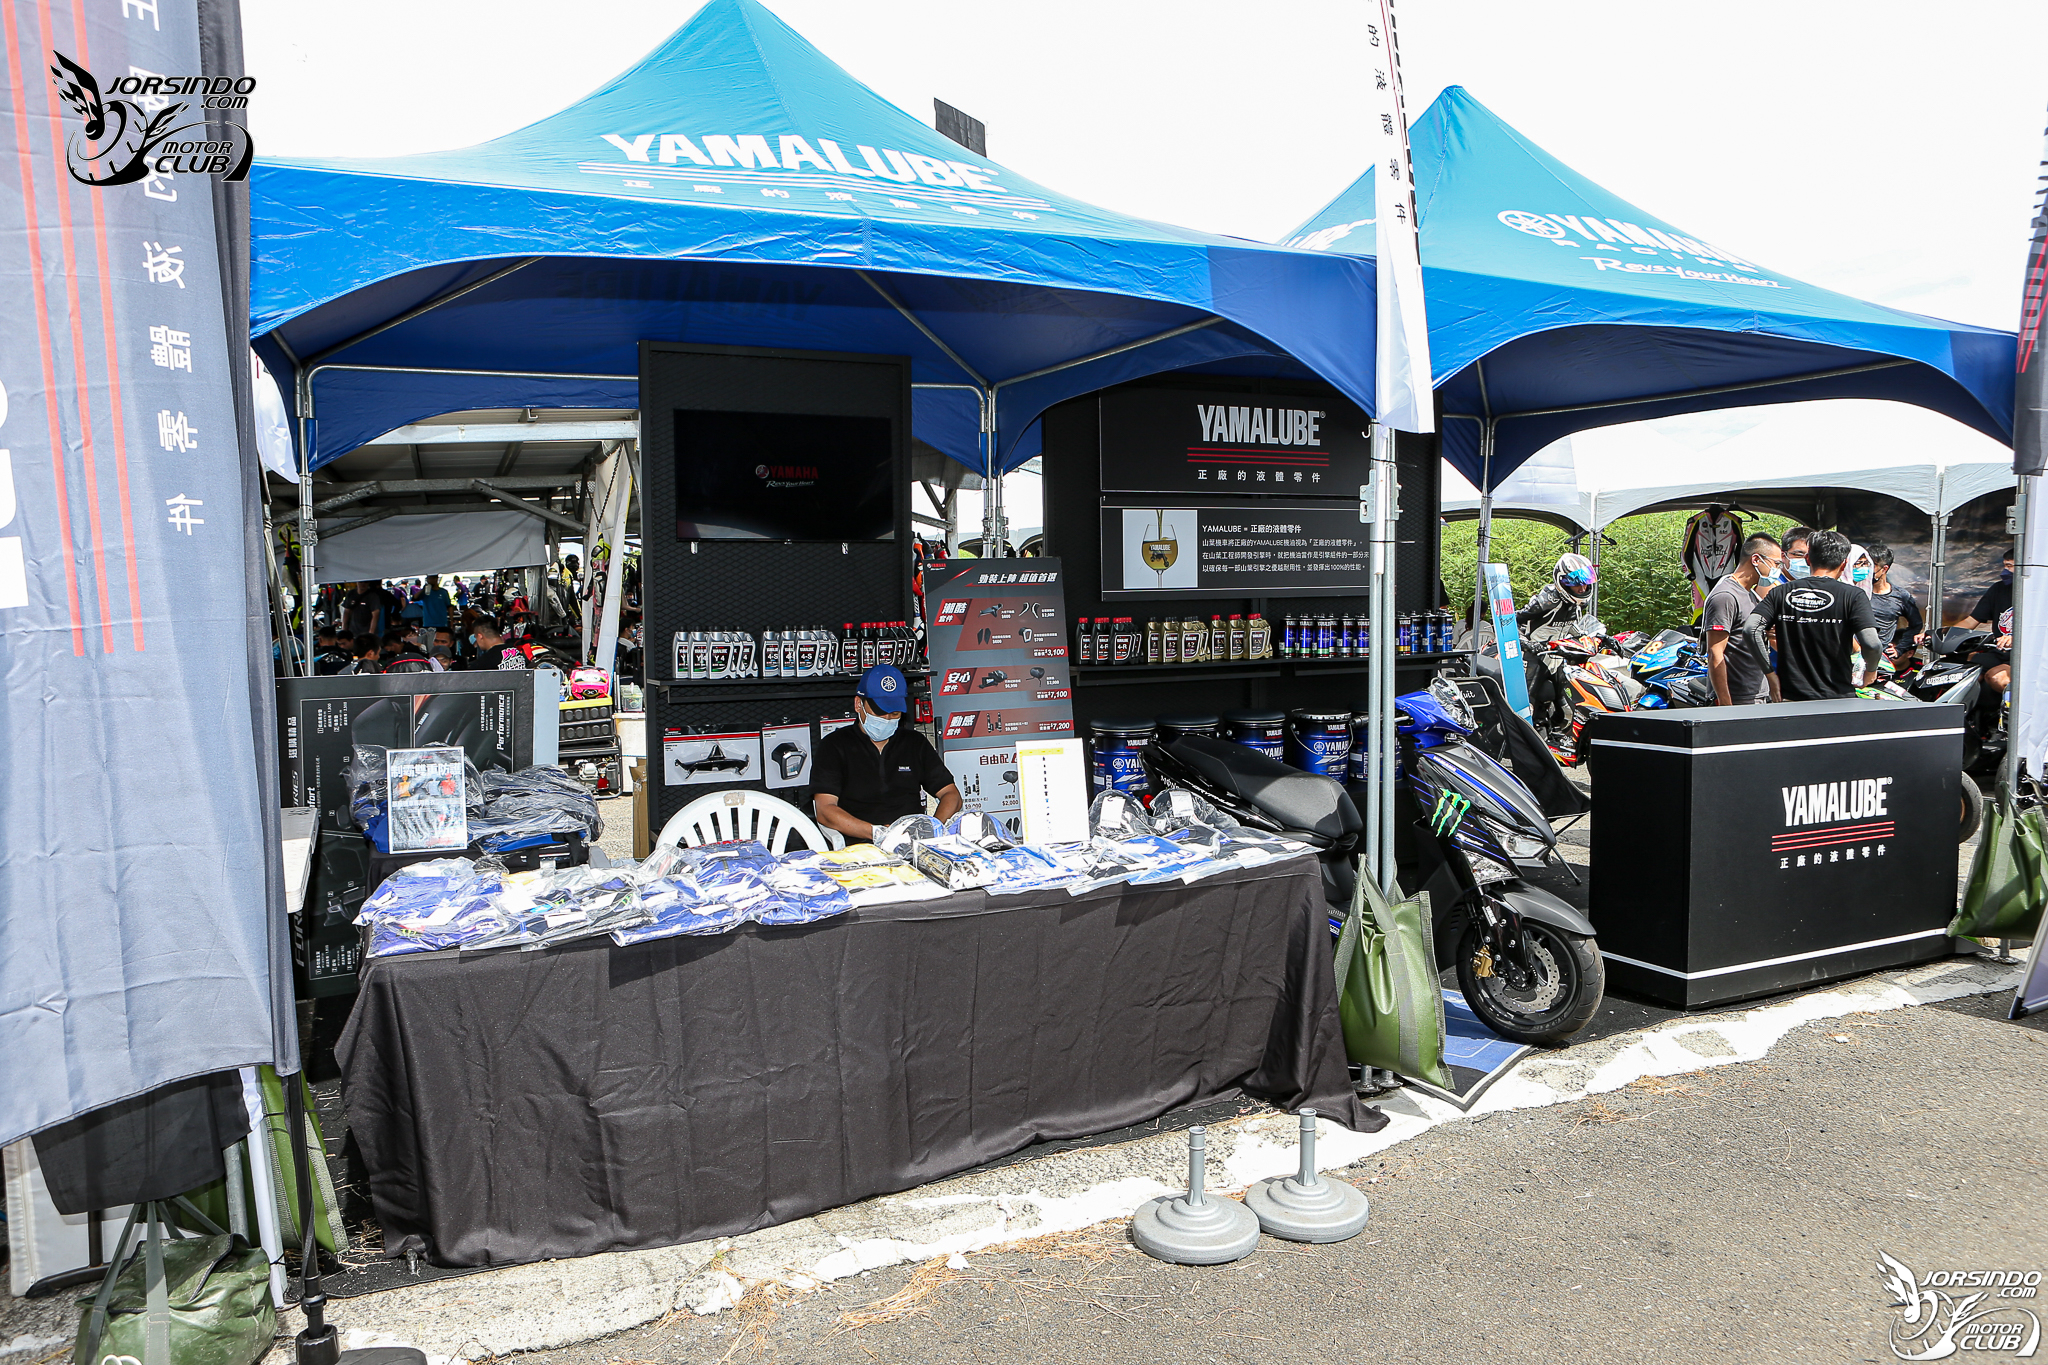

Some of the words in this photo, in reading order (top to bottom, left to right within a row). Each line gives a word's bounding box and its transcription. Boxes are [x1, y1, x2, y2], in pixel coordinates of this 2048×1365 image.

[770, 465, 819, 479] YAMAHA
[1198, 469, 1321, 483] 正廠的液體零件
[1202, 525, 1242, 534] YAMALUBE
[1250, 524, 1302, 534] 正廠的液體零件
[978, 573, 1018, 584] 勁裝上陣
[1018, 572, 1058, 583] 超值首選
[942, 602, 968, 614] 潮酷
[947, 672, 972, 684] 安心
[943, 684, 958, 692] 套件
[496, 694, 505, 751] Performance
[950, 714, 976, 728] 動感
[288, 716, 298, 759] 選購精品
[946, 728, 962, 736] 套件
[980, 753, 1009, 766] 自由配
[1780, 843, 1886, 870] 正廠的液體零件
